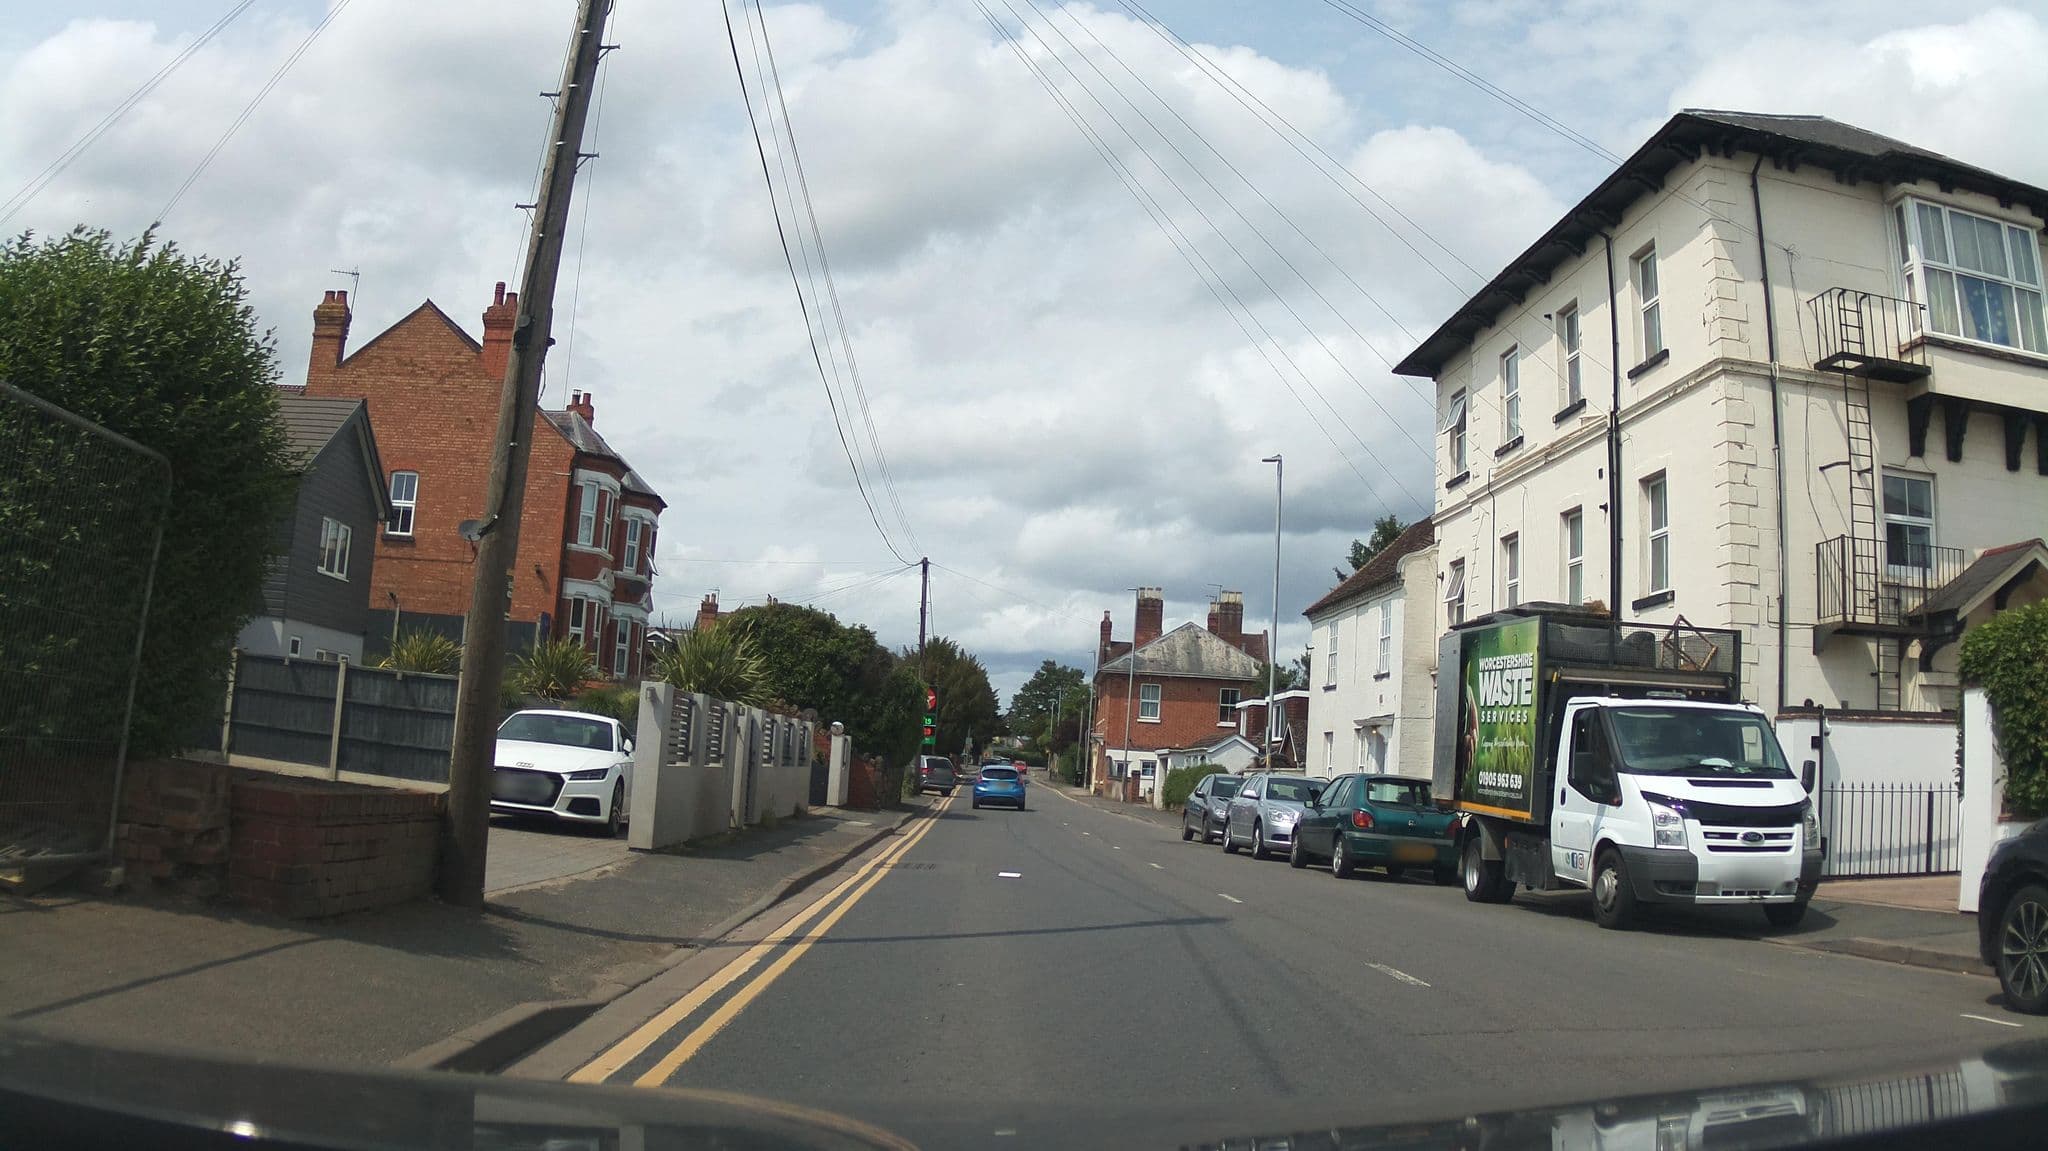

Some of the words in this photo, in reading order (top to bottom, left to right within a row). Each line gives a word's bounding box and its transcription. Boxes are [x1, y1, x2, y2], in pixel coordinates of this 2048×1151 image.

[1479, 652, 1533, 670] WORCESTERSHIRE
[1479, 667, 1533, 706] WASTE
[1480, 709, 1528, 723] SERVICES
[1478, 771, 1496, 787] 01905
[1497, 772, 1509, 788] 963
[1510, 773, 1522, 790] 639
